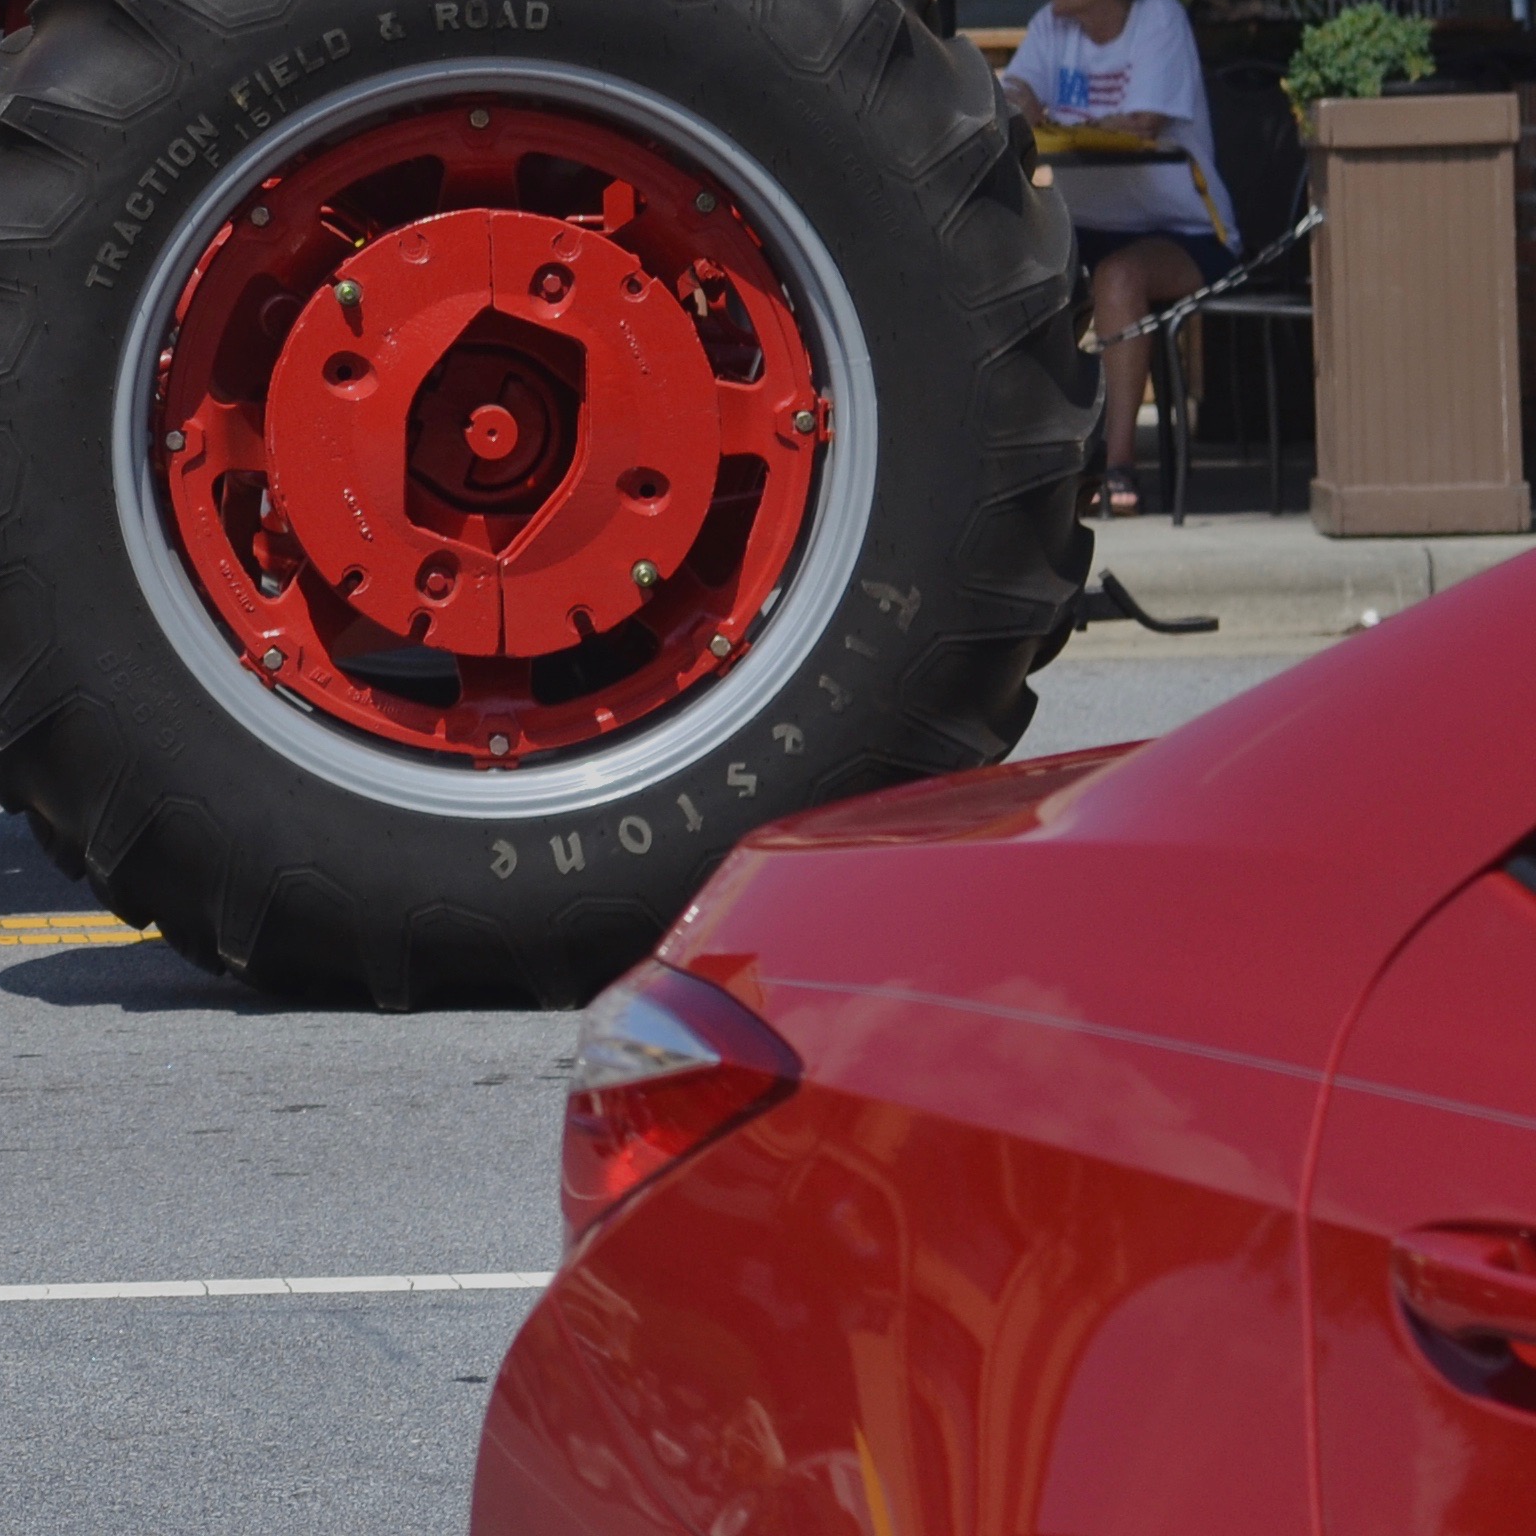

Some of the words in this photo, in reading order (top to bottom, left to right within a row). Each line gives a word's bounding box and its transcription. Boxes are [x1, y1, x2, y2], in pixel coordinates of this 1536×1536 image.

[84, 112, 220, 292] TRACTION
[230, 27, 352, 111] FIELD
[435, 0, 550, 33] ROAD
[489, 578, 921, 880] Firestone
